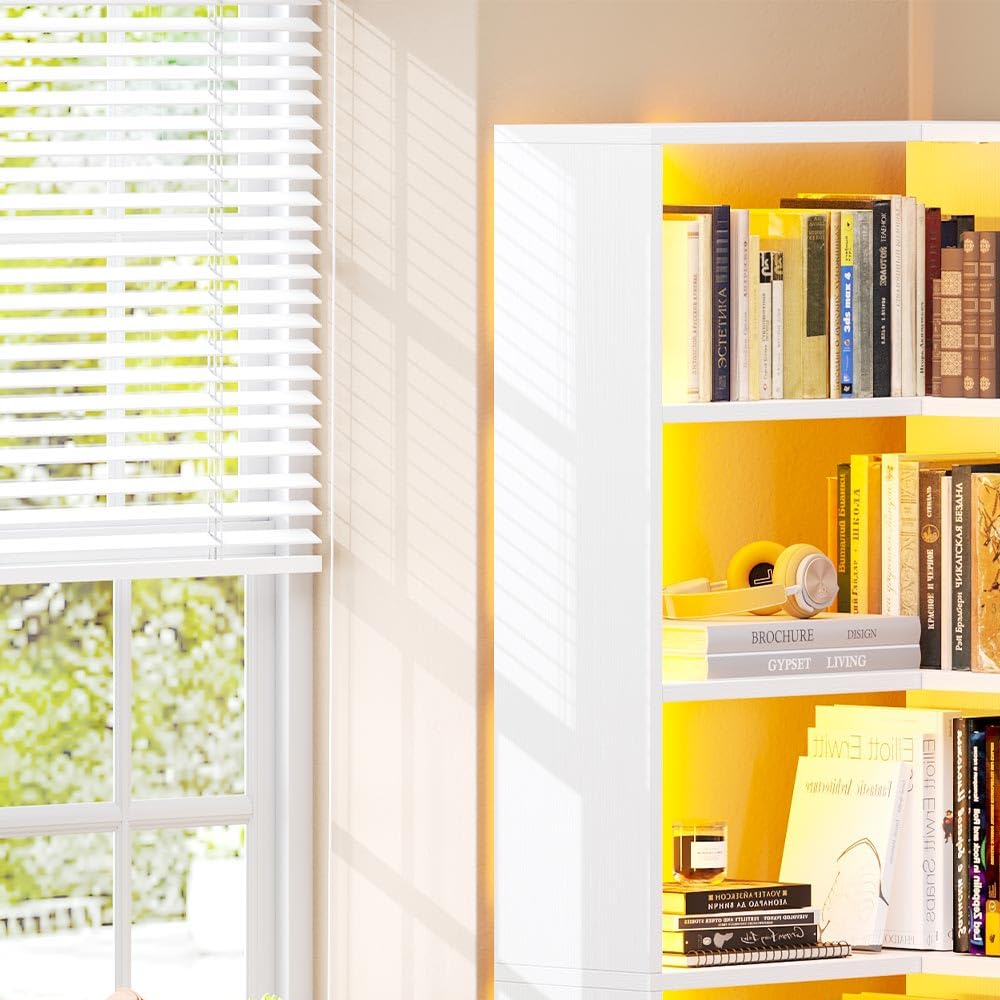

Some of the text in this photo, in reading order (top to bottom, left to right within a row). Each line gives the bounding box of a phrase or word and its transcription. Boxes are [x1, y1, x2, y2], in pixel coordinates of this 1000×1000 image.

[880, 246, 888, 286] ЗОЛОТОЙ
[843, 272, 851, 333] 3ds max 4
[717, 288, 727, 369] ЭСТЕТИКА
[852, 489, 860, 541] ШКОЛА
[927, 549, 935, 582] ЧЕРНОЕ
[955, 482, 964, 651] Рэй Брэдбери ЧИКАГСКАЯ БЕЗДНА
[927, 593, 935, 630] КРАСНОЕ
[751, 628, 877, 644] BROCHURE DISIGN
[768, 655, 866, 672] GYPSET LIVING
